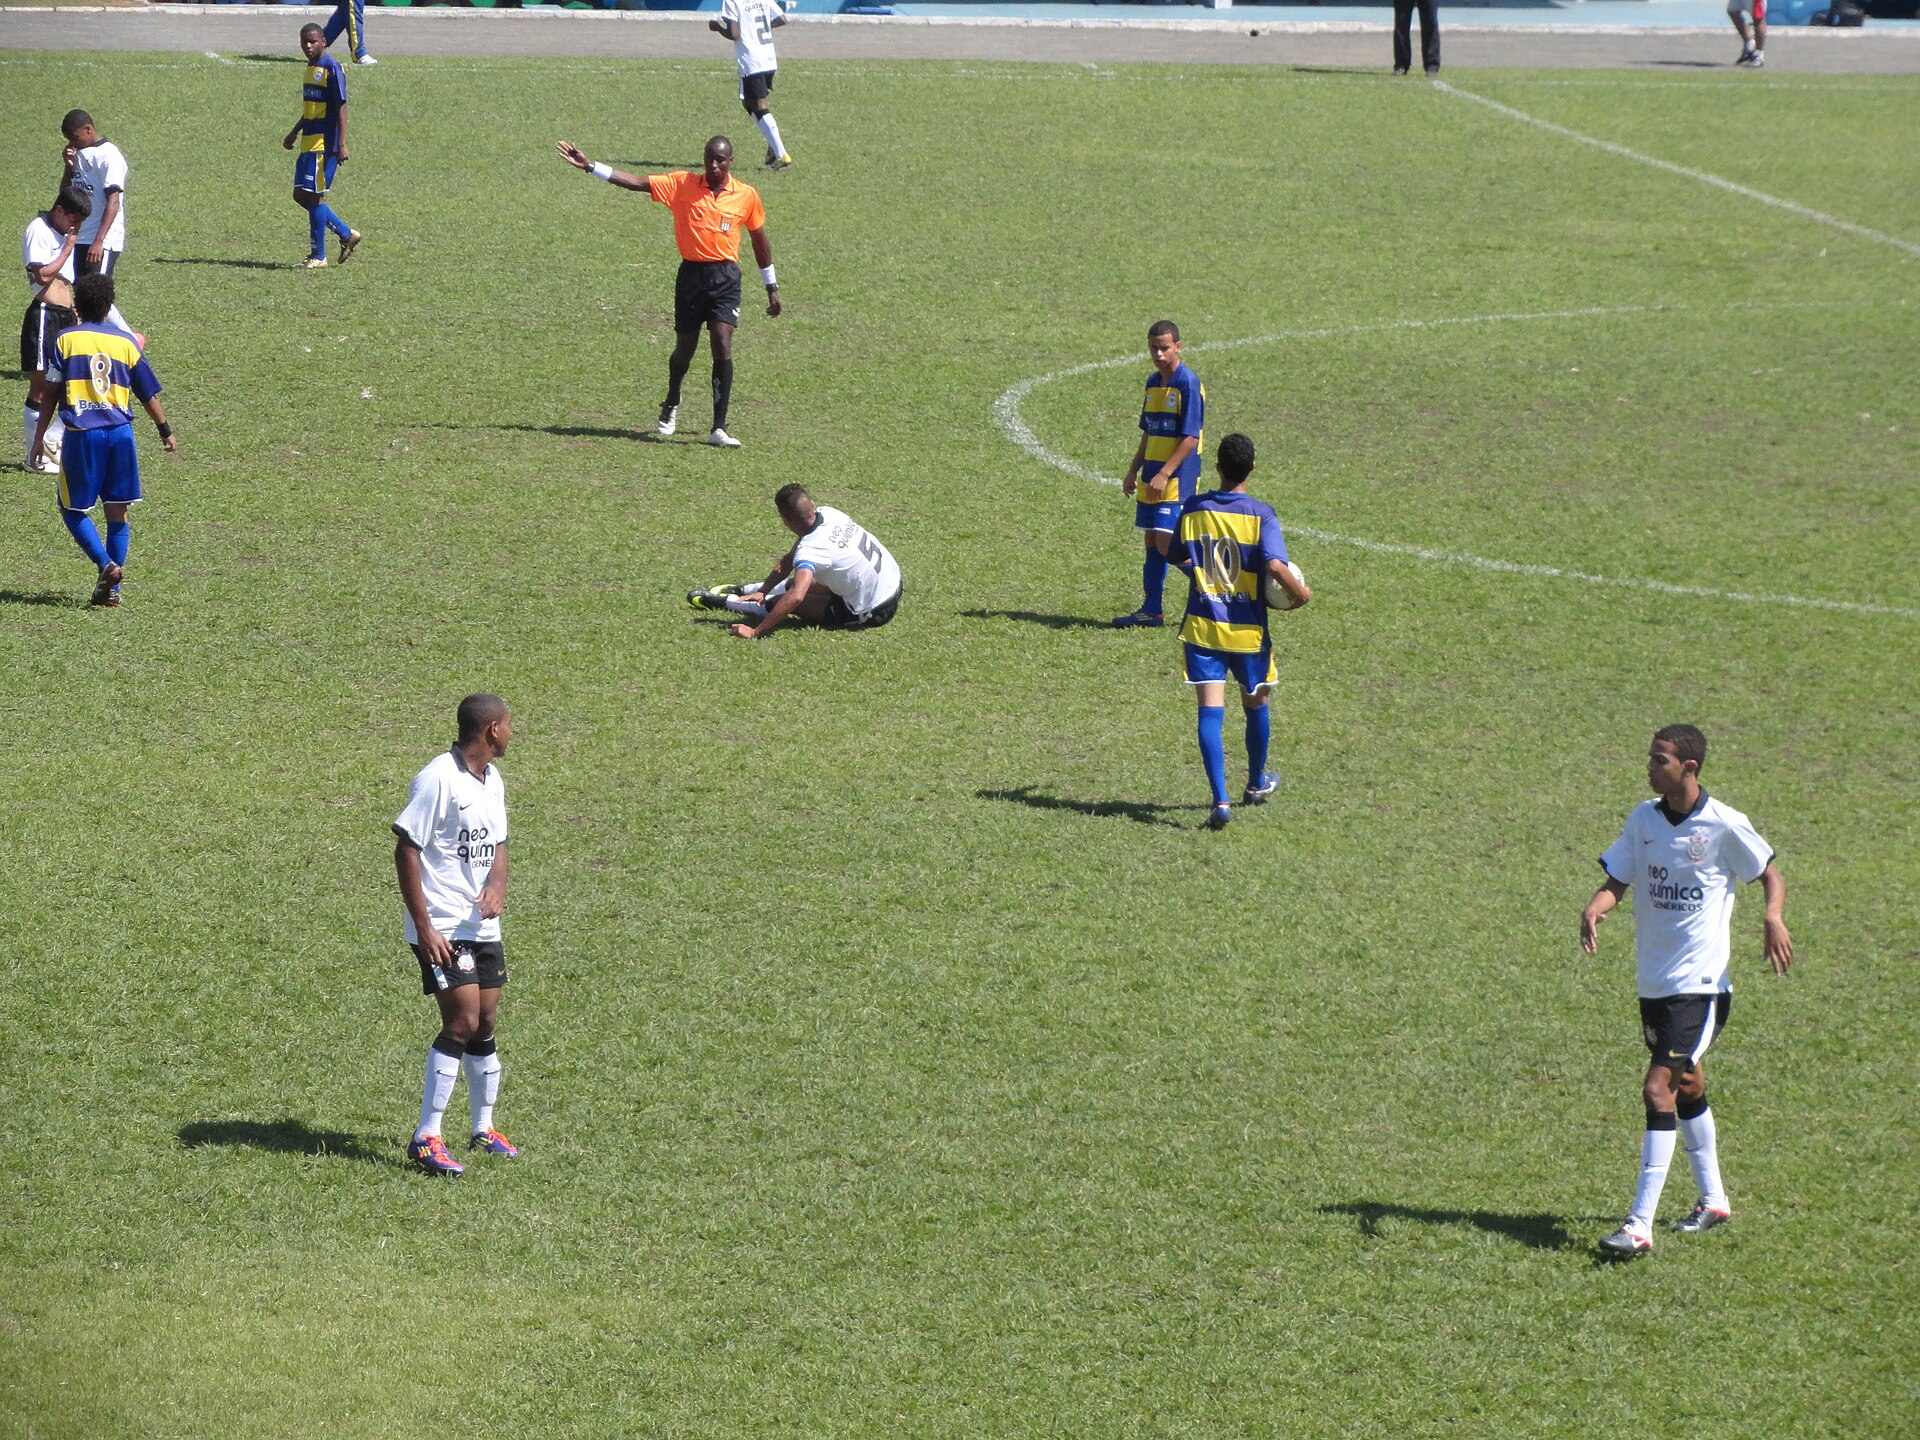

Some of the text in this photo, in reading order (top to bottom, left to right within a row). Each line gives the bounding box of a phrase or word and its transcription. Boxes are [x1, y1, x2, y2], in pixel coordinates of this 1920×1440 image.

[755, 14, 774, 45] 2
[90, 352, 112, 397] 8
[858, 531, 882, 575] 5
[1199, 533, 1241, 592] 10
[458, 827, 489, 842] neo
